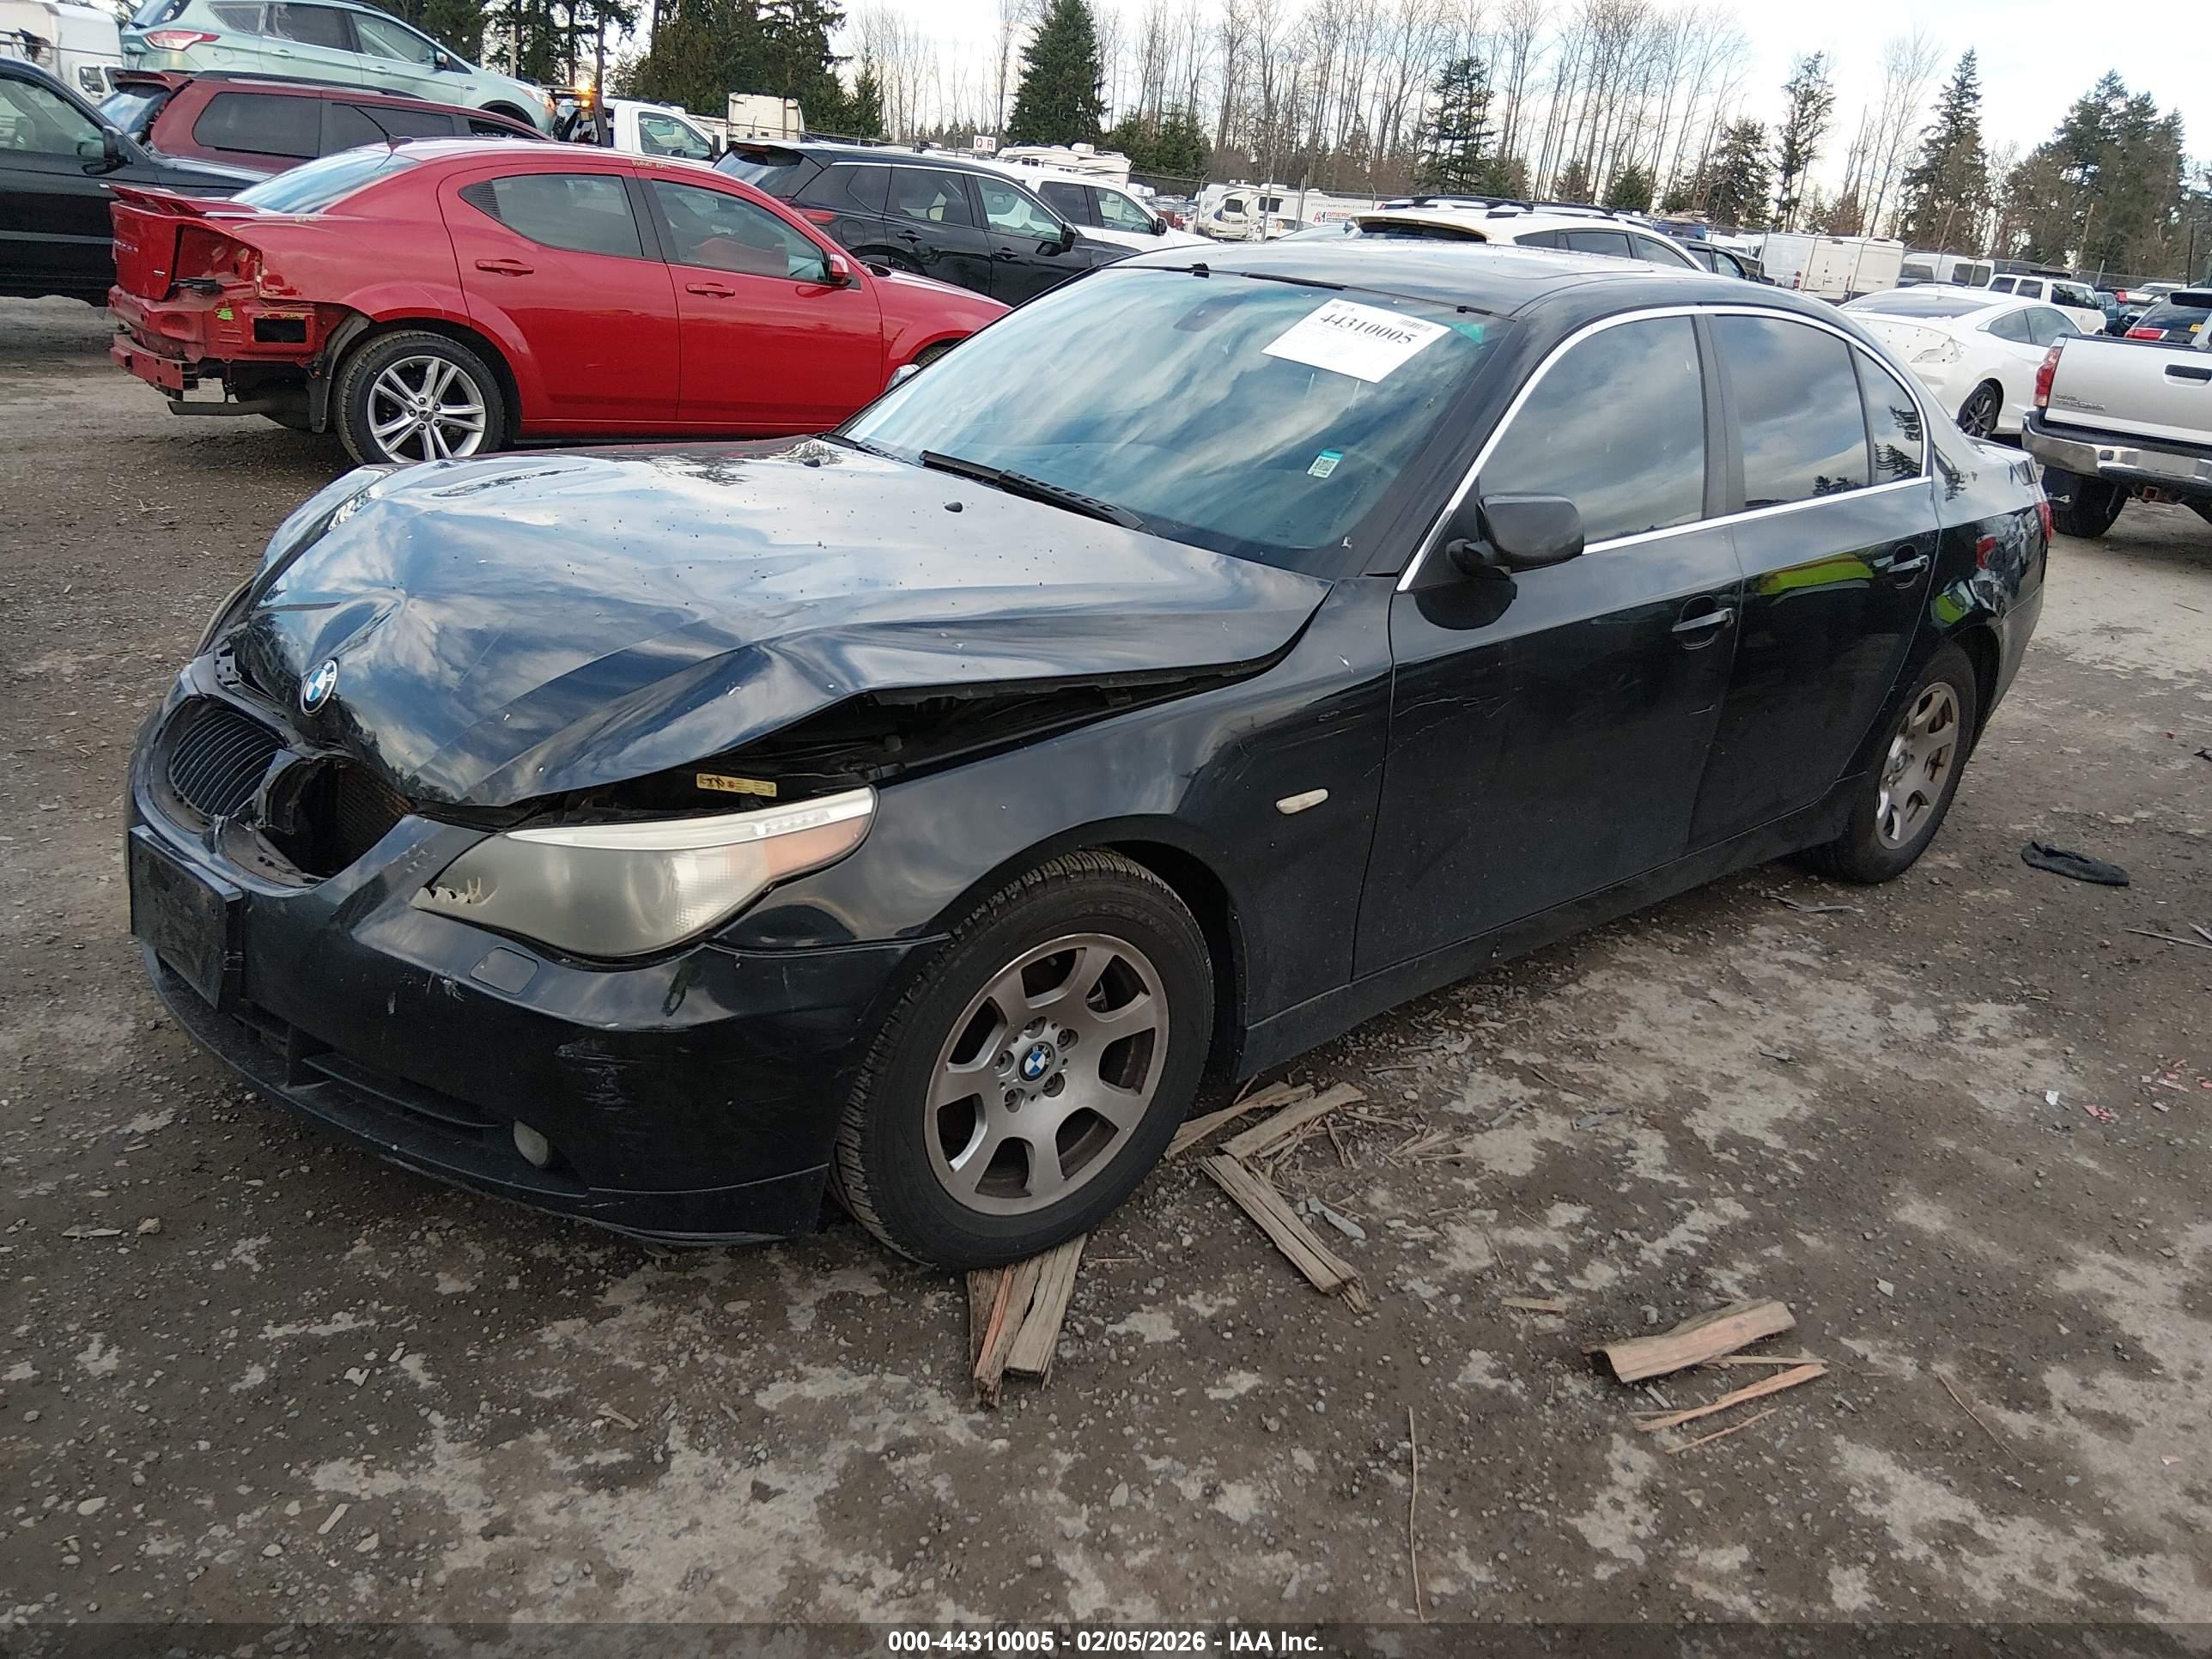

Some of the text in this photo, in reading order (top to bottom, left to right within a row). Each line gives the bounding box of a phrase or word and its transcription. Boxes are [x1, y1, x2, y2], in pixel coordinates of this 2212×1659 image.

[975, 137, 994, 149] Q R
[1320, 313, 1418, 344] 44310005
